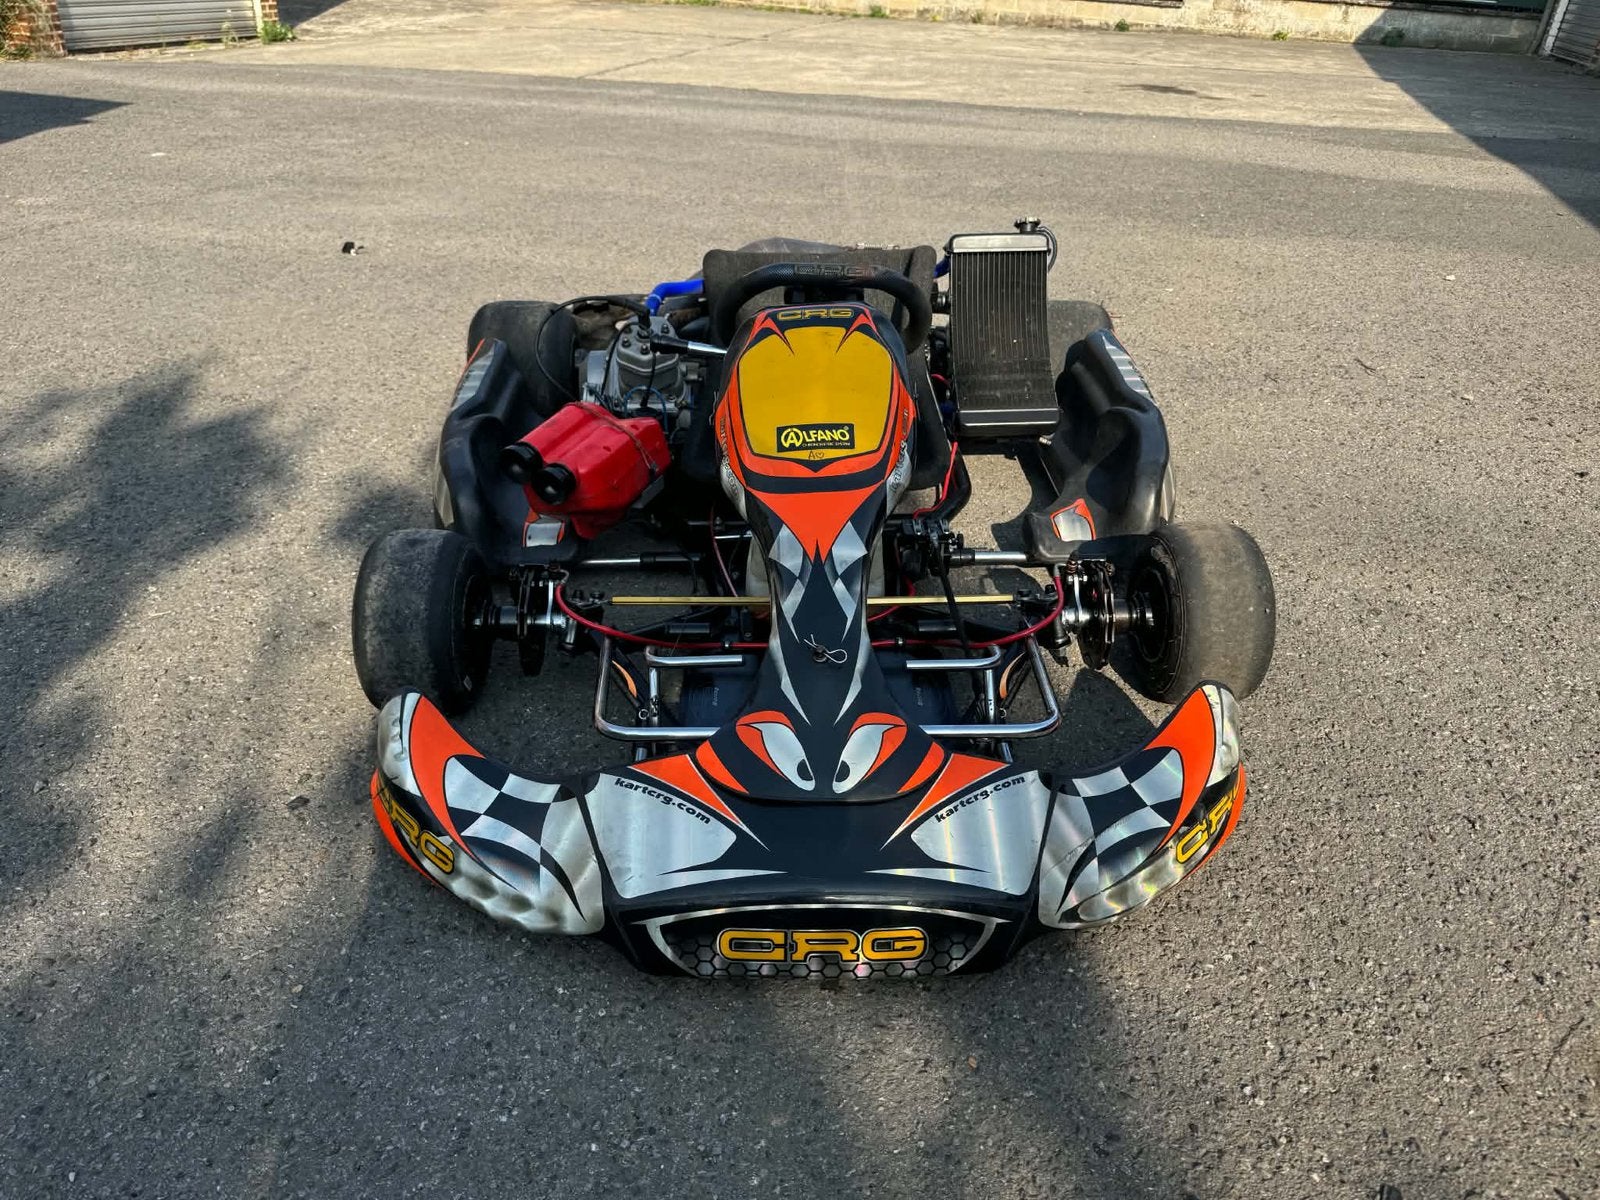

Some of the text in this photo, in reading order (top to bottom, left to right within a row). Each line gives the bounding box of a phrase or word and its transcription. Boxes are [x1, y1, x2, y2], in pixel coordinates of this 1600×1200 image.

[777, 308, 854, 321] CRG
[780, 427, 850, 448] ALFANO
[614, 778, 711, 825] kartcrg.com
[934, 776, 1026, 823] kartcrg.com
[1176, 780, 1241, 864] CR
[717, 928, 929, 964] CRG
